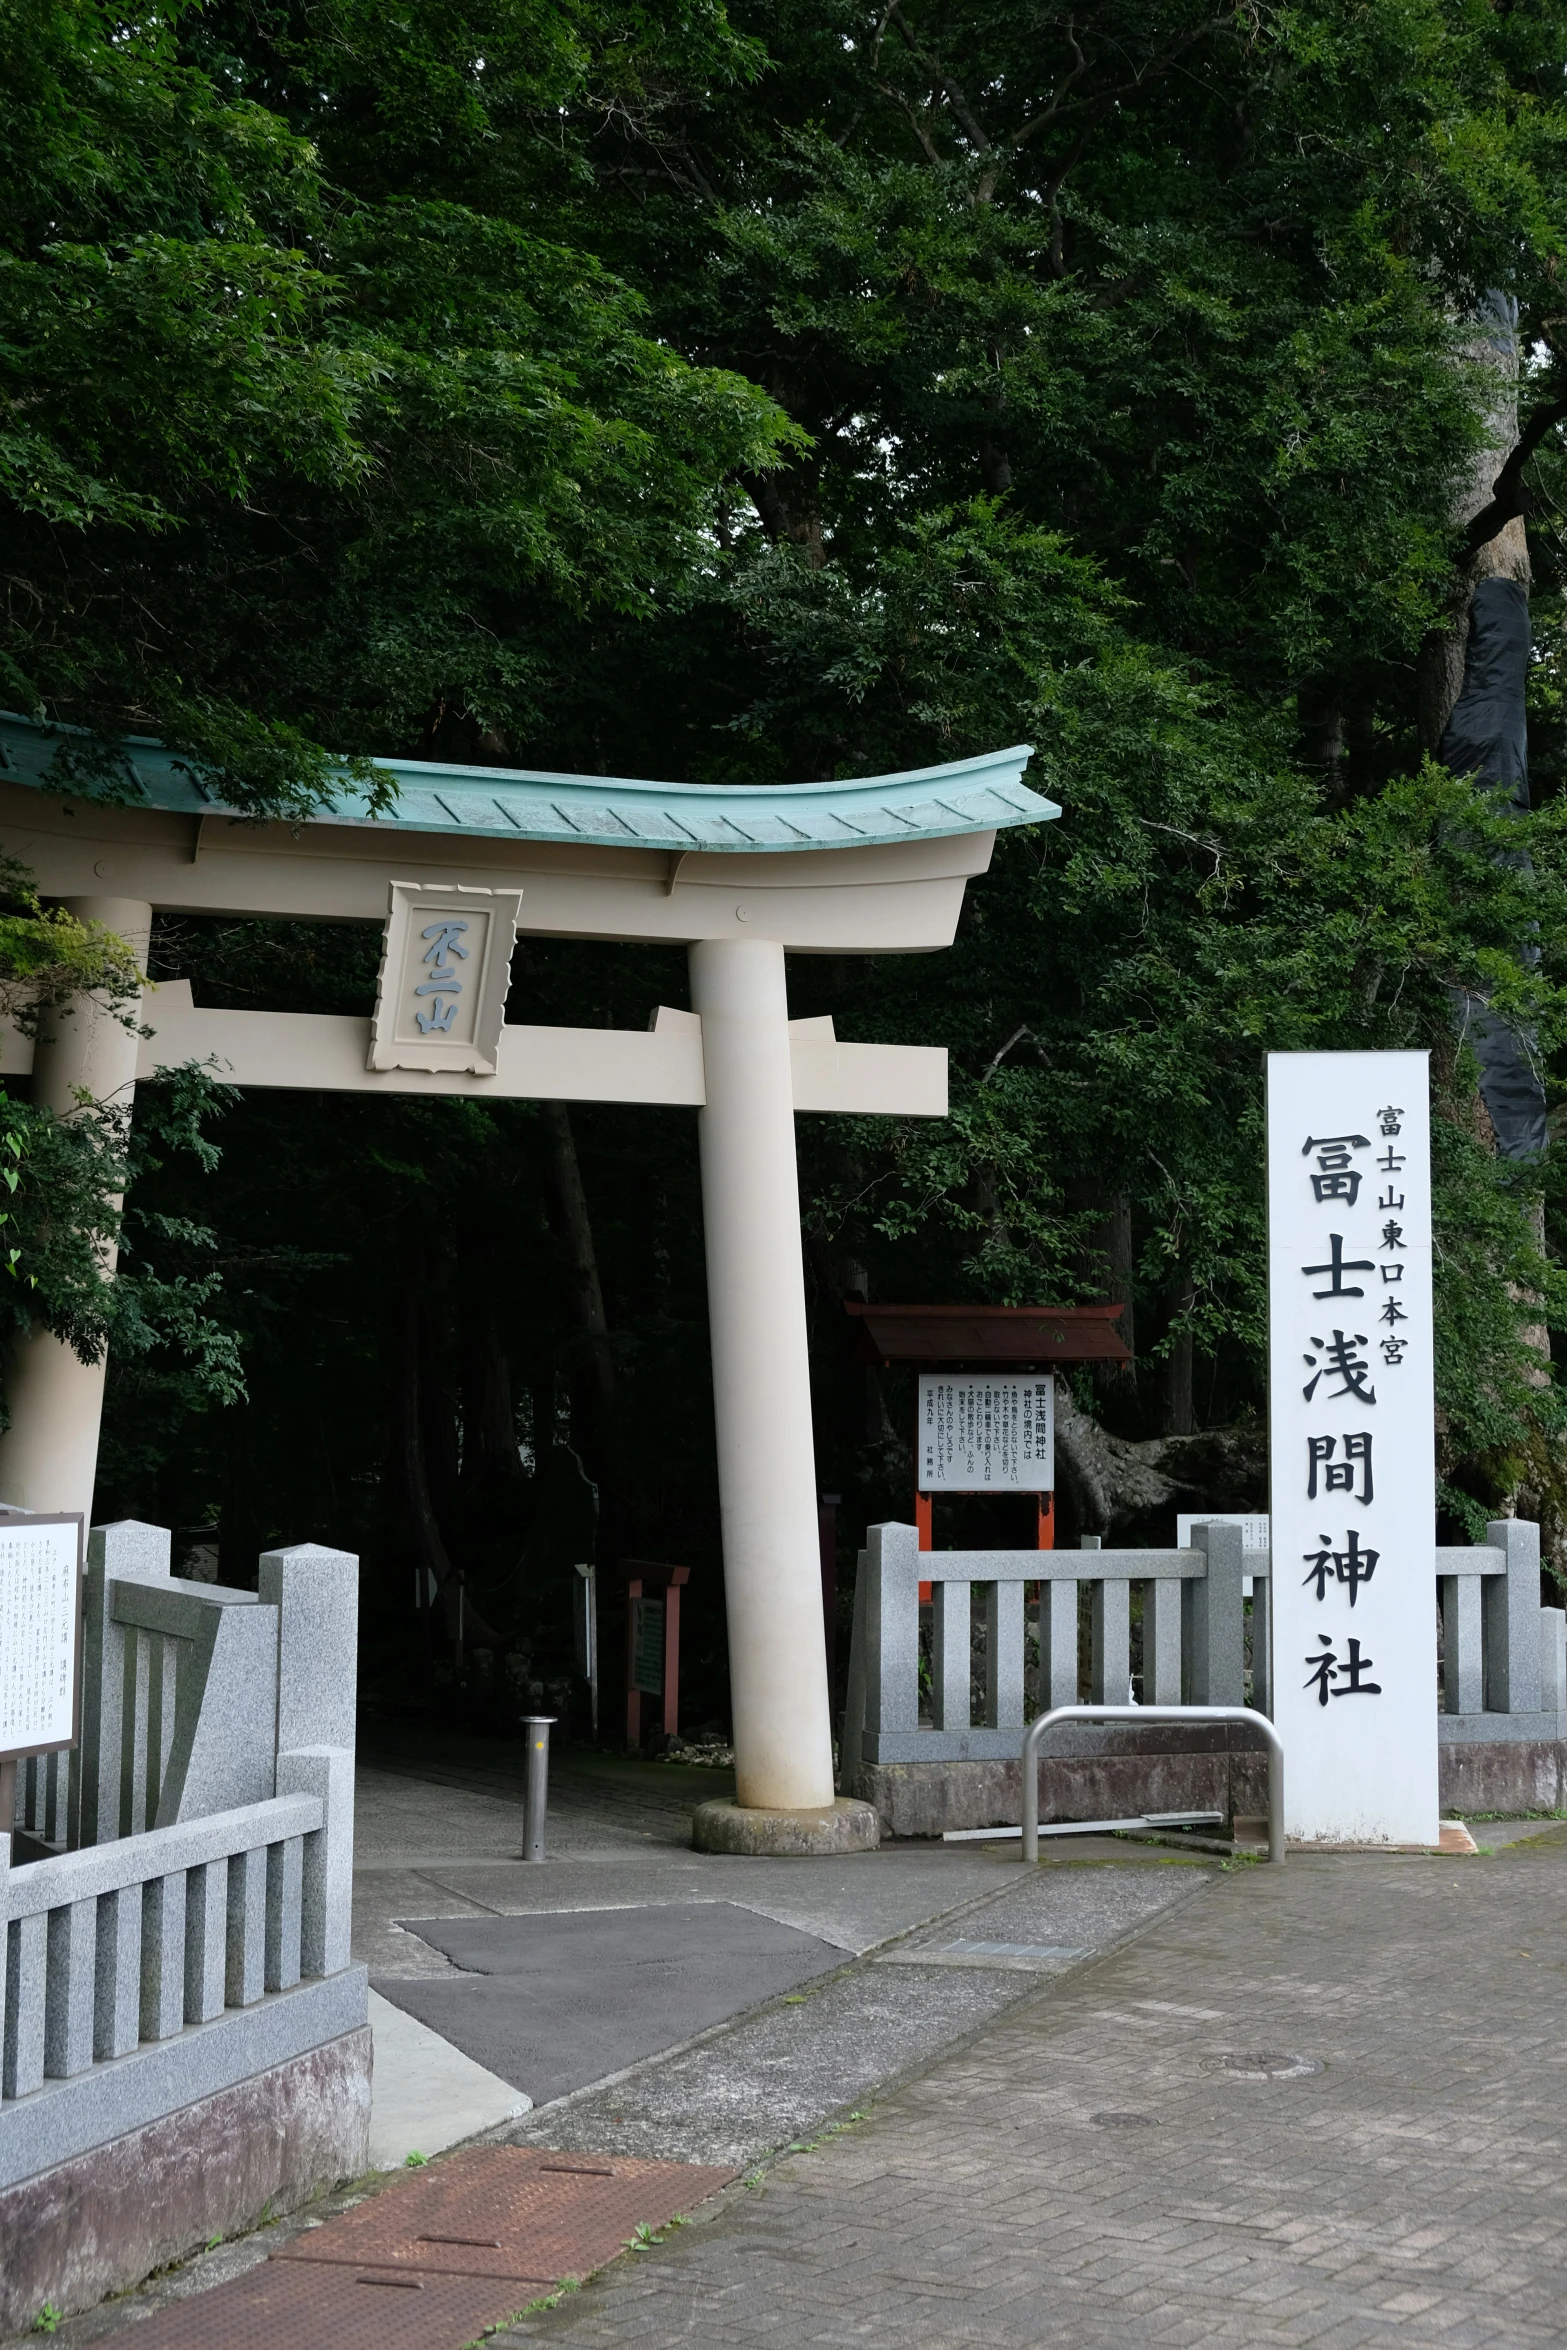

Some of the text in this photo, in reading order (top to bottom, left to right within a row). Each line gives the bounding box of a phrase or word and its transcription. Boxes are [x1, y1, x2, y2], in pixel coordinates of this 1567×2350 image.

[415, 920, 470, 1034] 不二山
[1376, 1104, 1408, 1366] 富士山東口本宮
[926, 1390, 934, 1425] 平成九年
[937, 1385, 946, 1481] きれいに大切にして下さい。
[946, 1385, 954, 1463] みなさんのやしろです
[958, 1391, 966, 1454] 始末をして下さい。
[993, 1391, 1001, 1454] 取らないで下さい。
[1023, 1389, 1033, 1460] 神社の境内では
[1301, 1134, 1383, 1708] 冨士浅間神社
